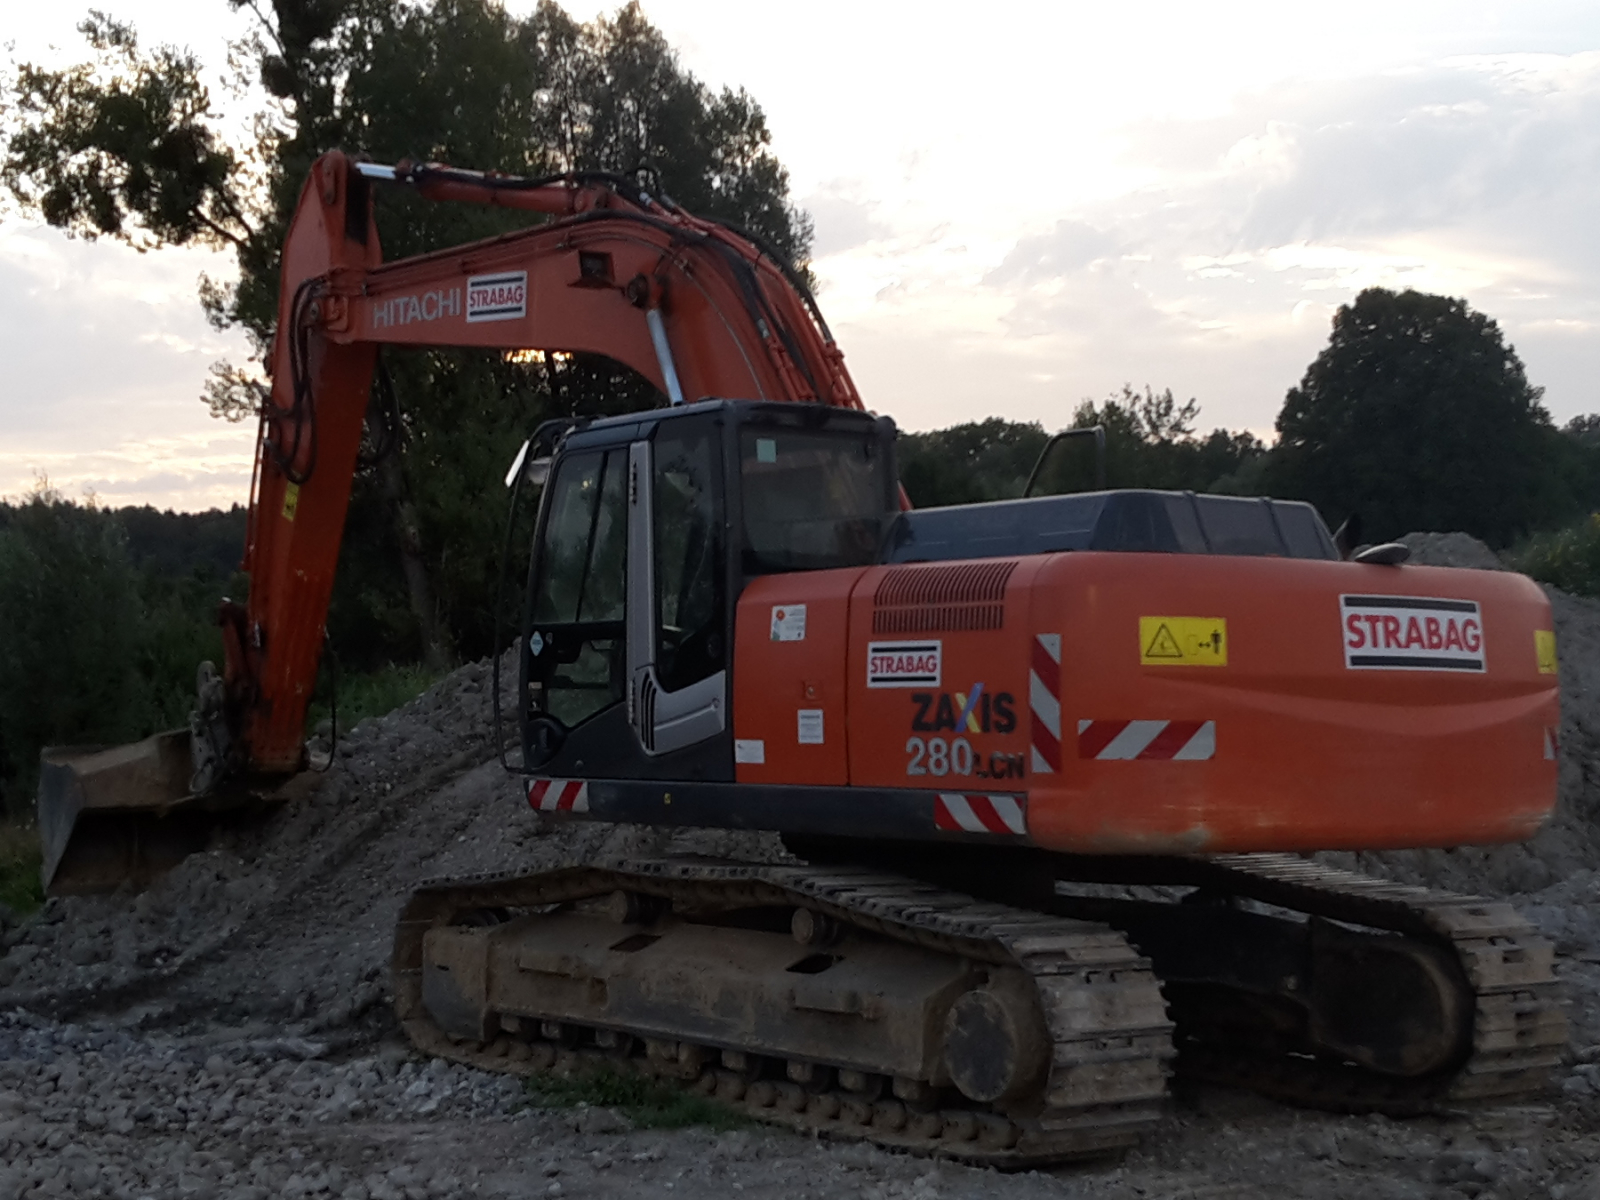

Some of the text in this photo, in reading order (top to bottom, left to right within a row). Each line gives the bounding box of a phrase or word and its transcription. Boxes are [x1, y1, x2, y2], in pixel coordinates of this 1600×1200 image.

[373, 288, 461, 328] HITACHI
[469, 285, 524, 308] STRABAG
[1346, 613, 1481, 653] STRABAG
[870, 654, 937, 675] STRABAG
[911, 682, 1017, 734] ZAXIS
